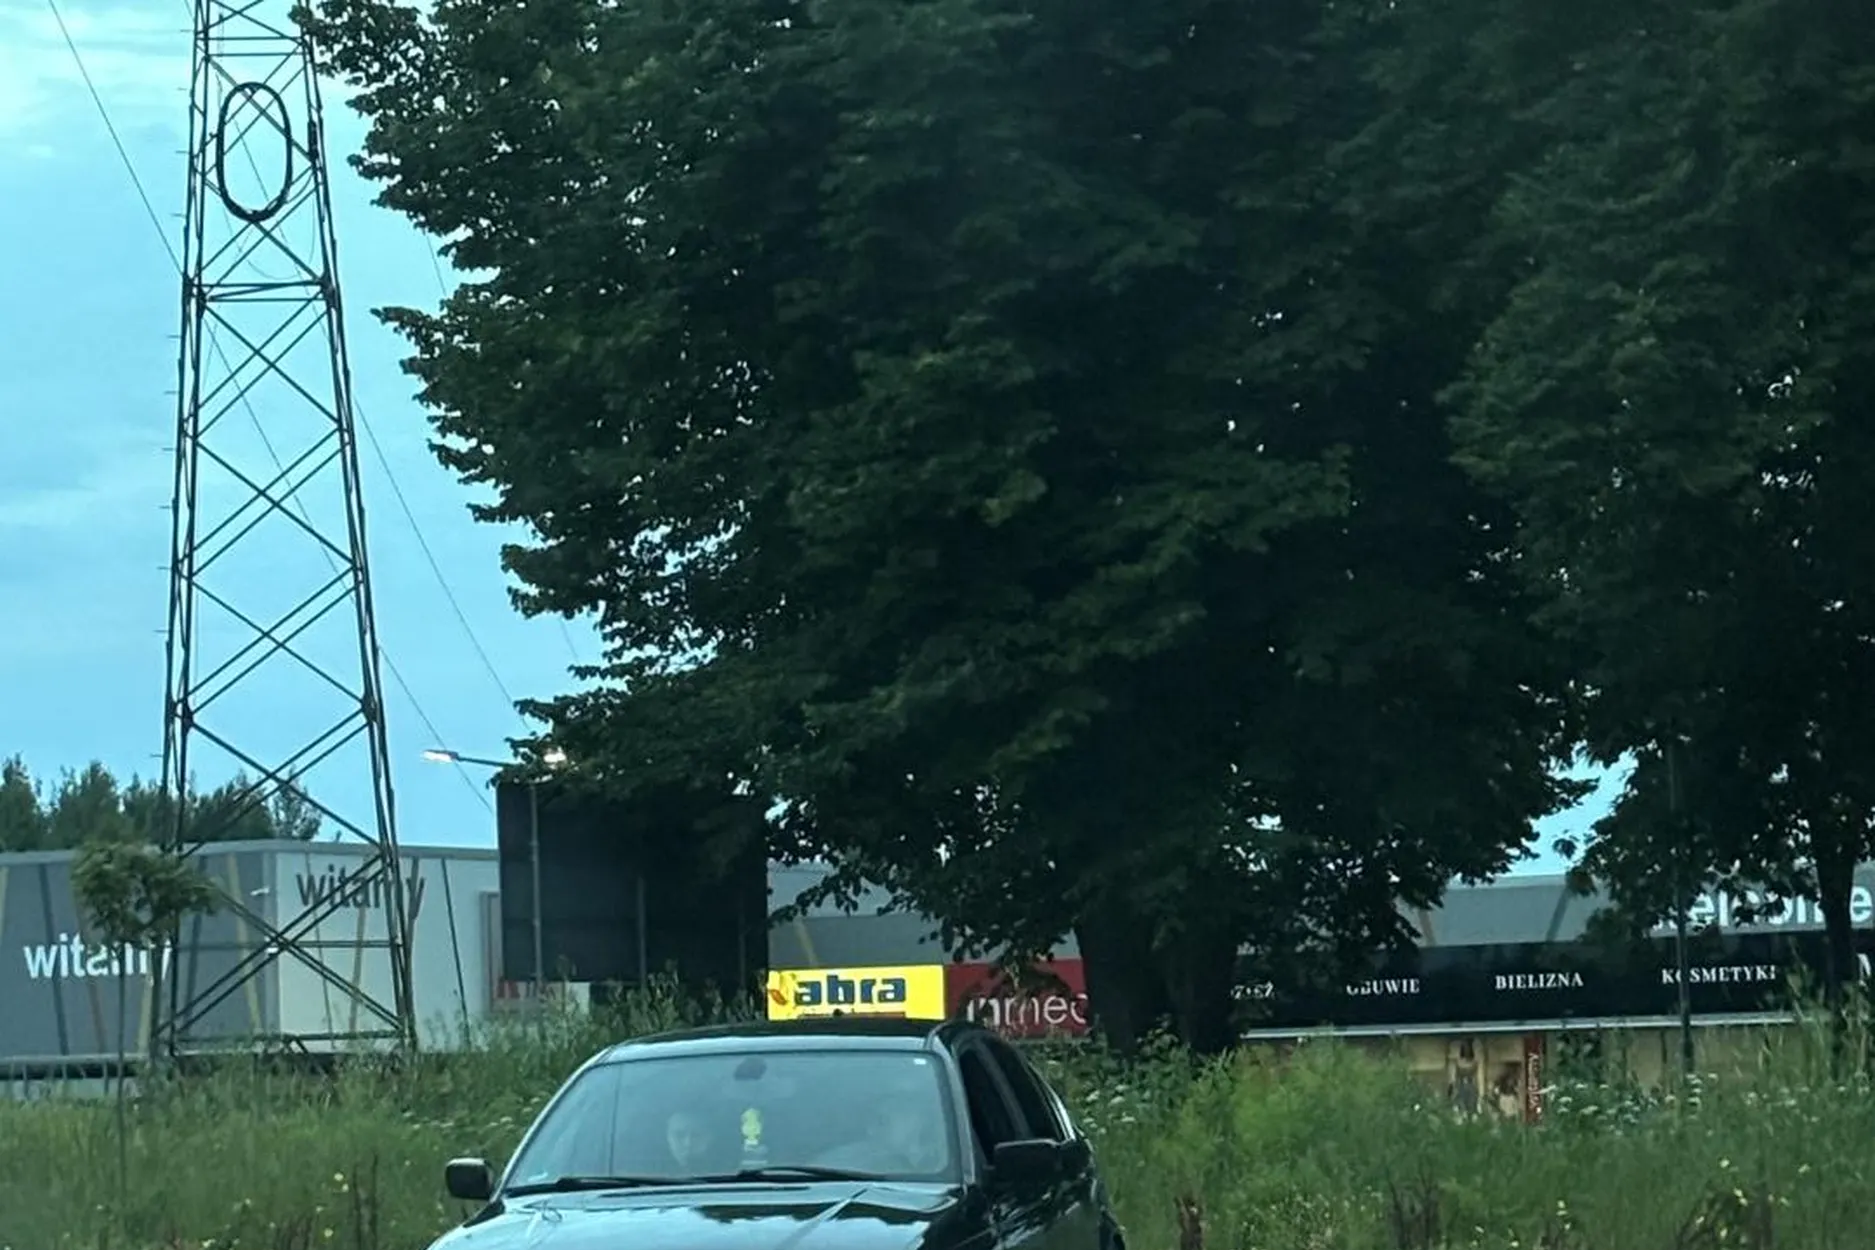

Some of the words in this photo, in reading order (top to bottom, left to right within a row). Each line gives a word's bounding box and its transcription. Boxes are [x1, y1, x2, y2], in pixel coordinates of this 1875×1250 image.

[296, 863, 426, 921] witay
[795, 974, 906, 1006] abra
[1495, 972, 1584, 990] BIELIZNA
